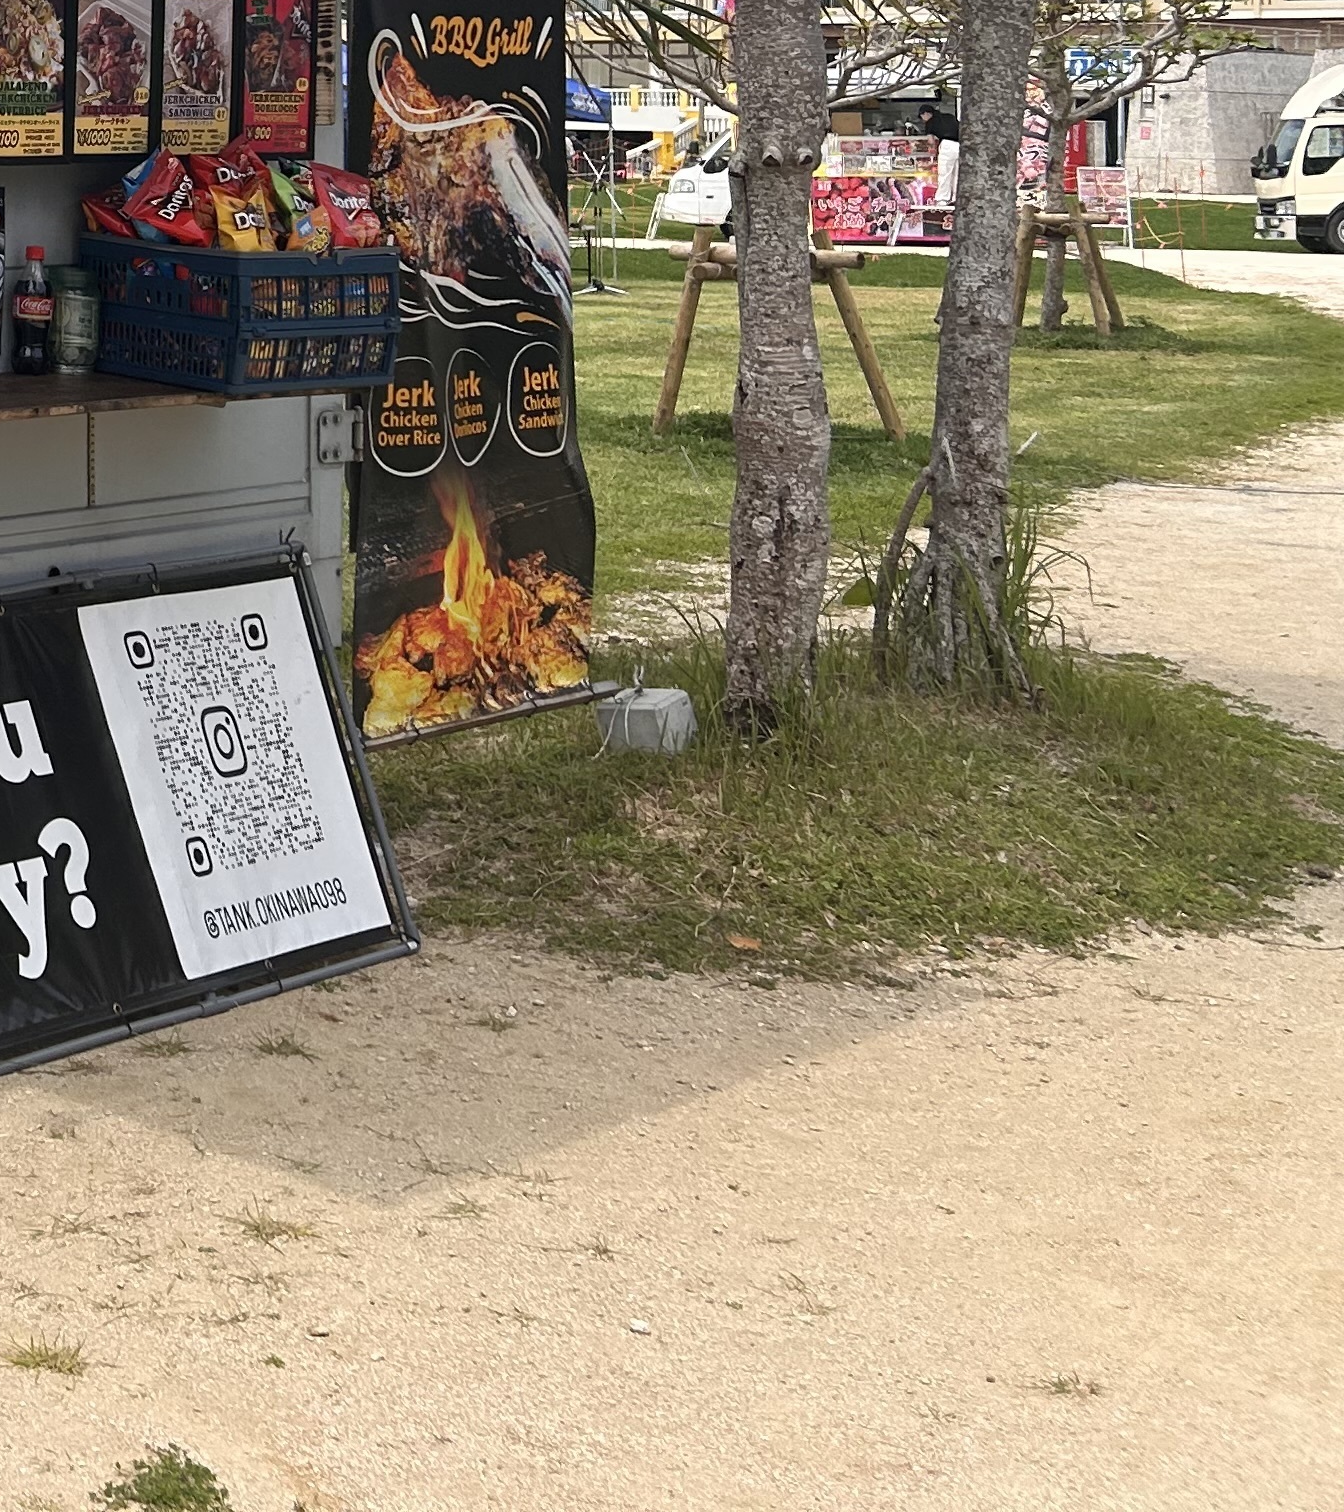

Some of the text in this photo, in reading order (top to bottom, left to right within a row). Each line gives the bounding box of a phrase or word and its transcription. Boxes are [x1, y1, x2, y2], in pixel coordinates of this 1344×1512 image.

[430, 15, 533, 68] BBQ Grill
[76, 128, 112, 146] ¥1000
[161, 129, 190, 146] ¥700
[158, 175, 194, 221] Doritos
[453, 370, 481, 400] Jerk
[523, 363, 560, 393] Jerk
[382, 380, 436, 408] Jerk
[380, 410, 438, 428] Chicken
[454, 402, 484, 420] Chicken
[378, 429, 441, 447] Over Rice
[203, 879, 349, 941] @TANK.OKINAWA098
